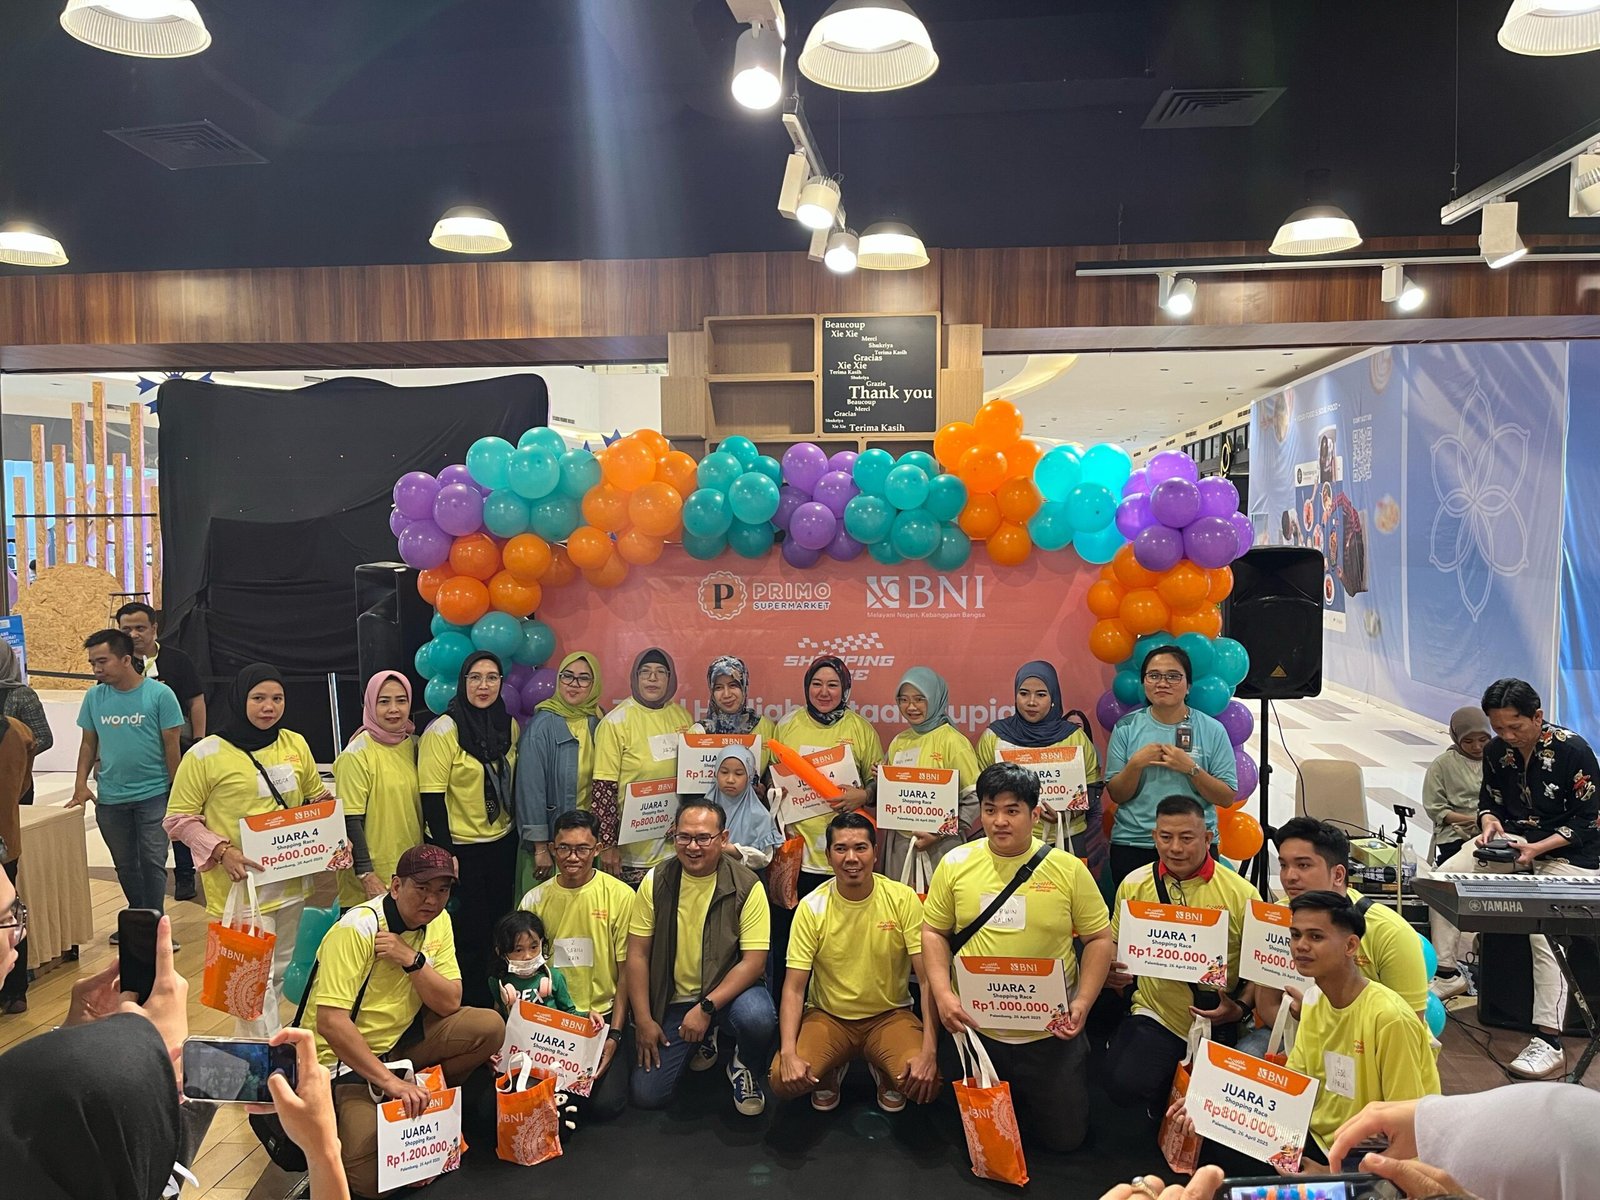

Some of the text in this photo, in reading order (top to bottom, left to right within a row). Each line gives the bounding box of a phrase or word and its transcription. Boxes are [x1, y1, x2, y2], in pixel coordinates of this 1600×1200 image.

[825, 320, 866, 330] Beaucoup
[831, 330, 859, 338] Xie Xie
[853, 353, 883, 361] Gracias
[837, 361, 868, 370] Xie Xie
[848, 385, 933, 403] Thank you
[849, 423, 905, 432] Terima Kasih
[712, 583, 734, 610] P
[752, 582, 832, 600] PRIMO
[908, 575, 985, 610] BNI
[752, 601, 831, 611] SUPERMARKET
[783, 655, 895, 667] SHPING
[100, 712, 146, 725] wondr
[700, 754, 718, 763] JUA
[820, 753, 834, 762] BNI
[1048, 752, 1063, 760] BNI
[829, 771, 835, 779] 4
[925, 773, 940, 781] BNI
[1055, 770, 1061, 778] 3
[898, 789, 936, 799] JUARA 2
[1039, 785, 1073, 795] 0.000,-
[640, 801, 663, 811] JUARA
[303, 808, 320, 819] BNI
[630, 814, 673, 829] Rp800.000,-
[271, 828, 319, 846] JUARA 4
[276, 841, 302, 850] Shopping
[261, 844, 333, 866] Rp600.000,-
[1481, 900, 1523, 913] YAMAHA
[1185, 912, 1203, 922] BNI
[1147, 928, 1196, 943] JUARA 1
[1265, 932, 1291, 948] JUAR
[1151, 939, 1178, 949] Shopping
[1128, 944, 1215, 966] Rp1.200.000,-
[1268, 944, 1290, 956] Shopping
[227, 951, 245, 962] BNI
[1254, 949, 1296, 971] Rp600.0
[1020, 963, 1038, 972] BNI
[986, 982, 1037, 993] JUARA 2
[972, 1000, 1057, 1014] Rp1.000.000,-
[569, 1021, 586, 1032] BNI
[530, 1032, 576, 1052] JUARA 2
[533, 1042, 569, 1057] Shopping Race
[1268, 1070, 1288, 1087] BNI
[429, 1097, 443, 1107] BNI
[1221, 1082, 1277, 1112] JUARA 3
[1225, 1096, 1268, 1118] Shopping Race
[504, 1112, 523, 1123] BNI
[1203, 1099, 1284, 1142] Rp800.000,-
[400, 1122, 439, 1140] JUARA 1
[1212, 1119, 1236, 1134] Palembang,
[1244, 1133, 1256, 1143] April
[404, 1137, 425, 1147] Shopping
[386, 1140, 453, 1169] Rp1.200.000,-
